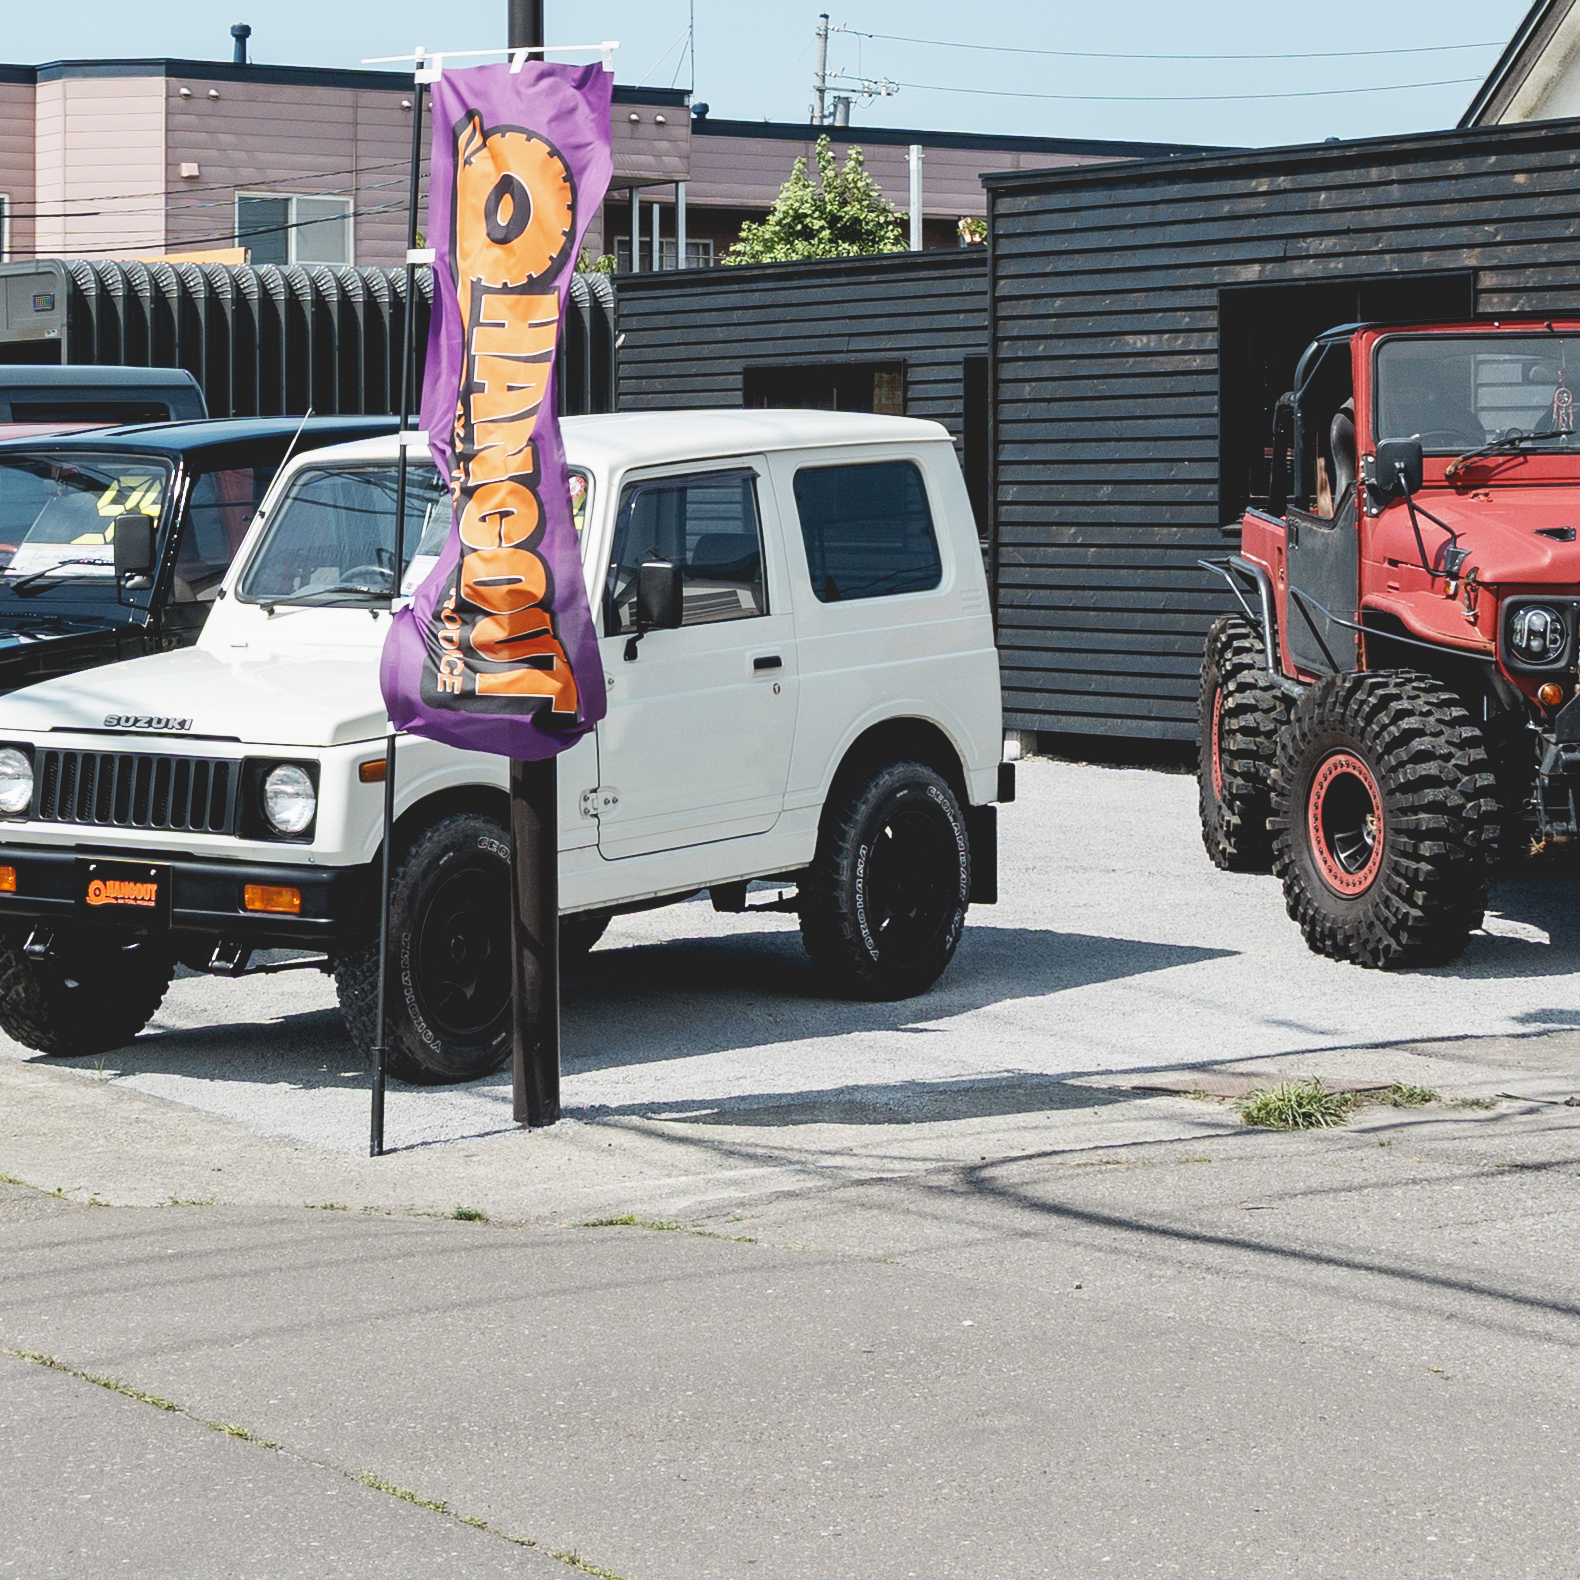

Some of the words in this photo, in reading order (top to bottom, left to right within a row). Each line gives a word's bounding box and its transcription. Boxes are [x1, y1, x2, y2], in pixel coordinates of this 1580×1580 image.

[460, 290, 579, 716] HANGOUT
[103, 714, 194, 731] SUZUKI
[105, 880, 158, 901] HANGOUT
[855, 845, 880, 962] YOKOHAMA
[400, 932, 443, 1054] YOKOHAMA
